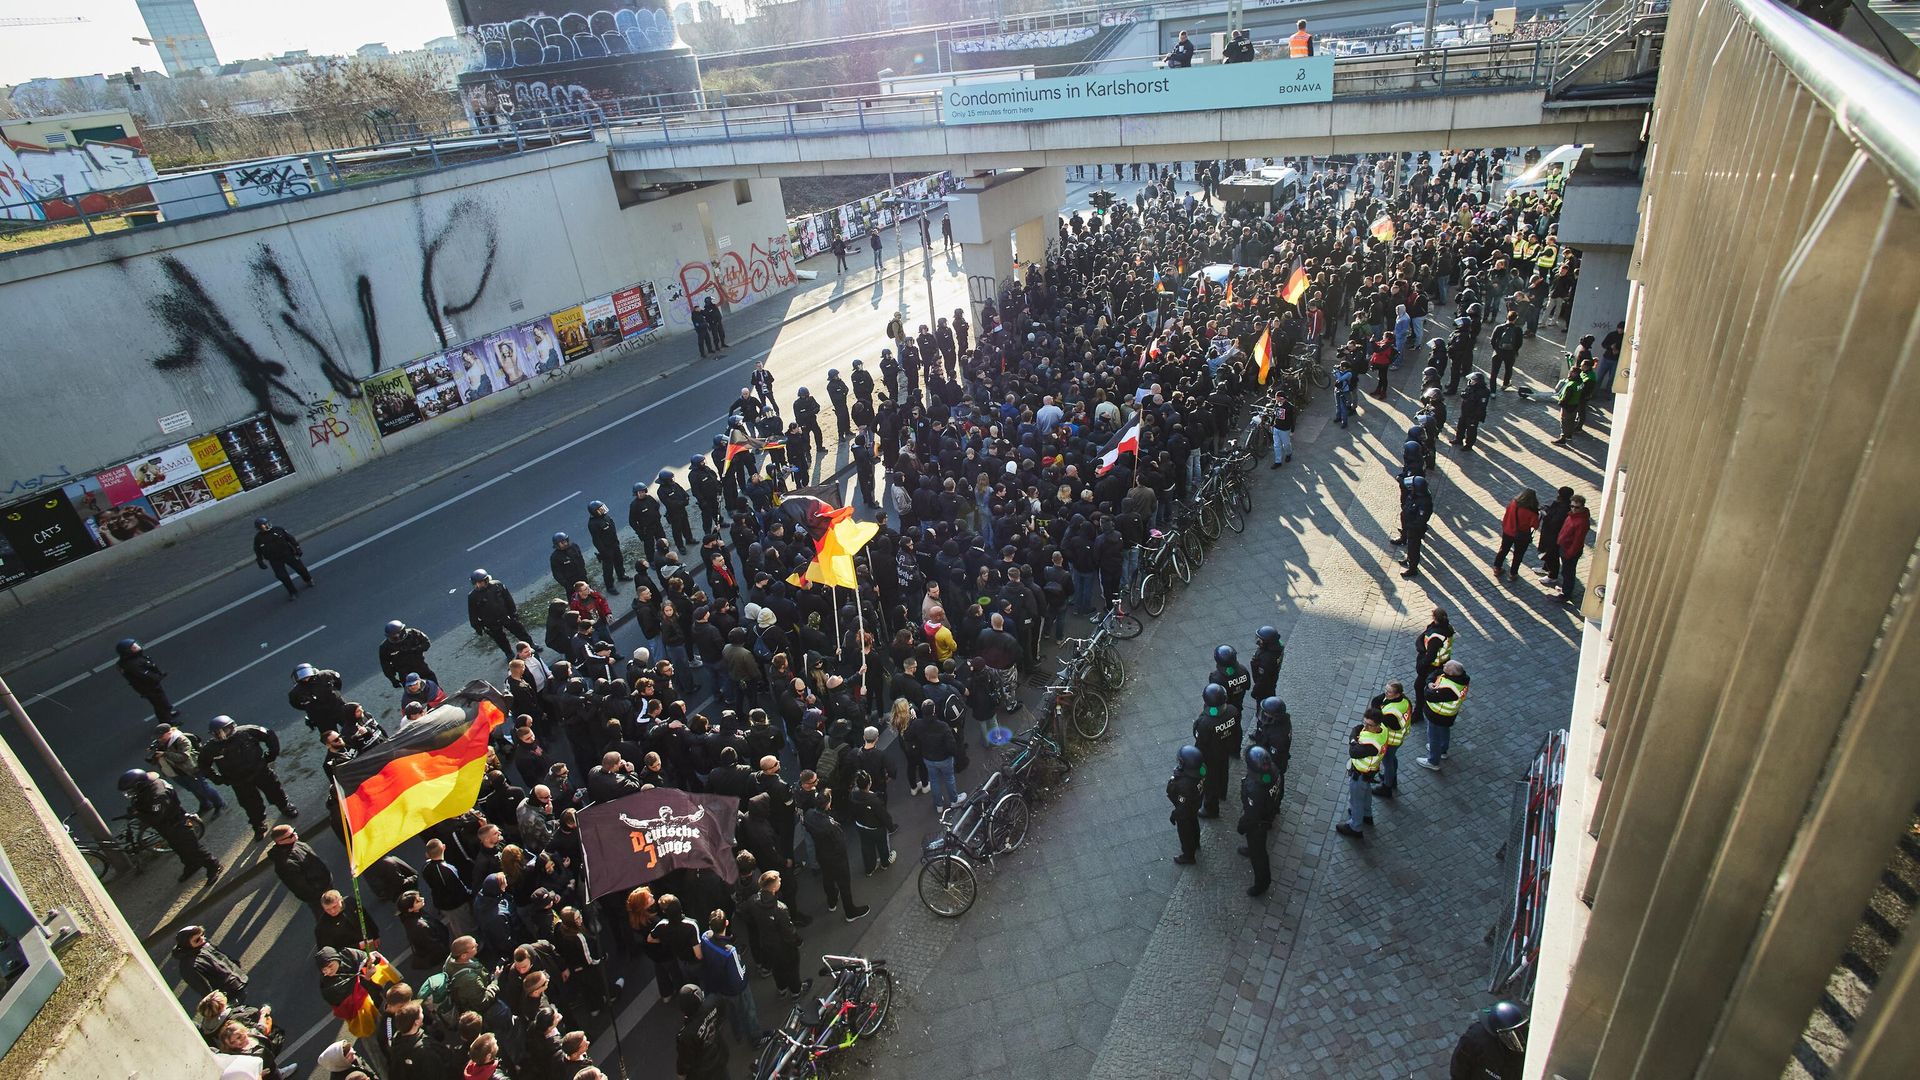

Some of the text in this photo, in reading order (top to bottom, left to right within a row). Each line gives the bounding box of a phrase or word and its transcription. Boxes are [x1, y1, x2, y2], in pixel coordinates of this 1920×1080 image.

[949, 77, 1170, 107] Condominiums in Karlshorst
[1279, 83, 1322, 94] BONAVA
[951, 106, 1034, 119] Only 15 minutes from here
[34, 524, 61, 544] CATS
[1228, 674, 1248, 688] POLIZEI
[1215, 717, 1236, 734] POLIZEI
